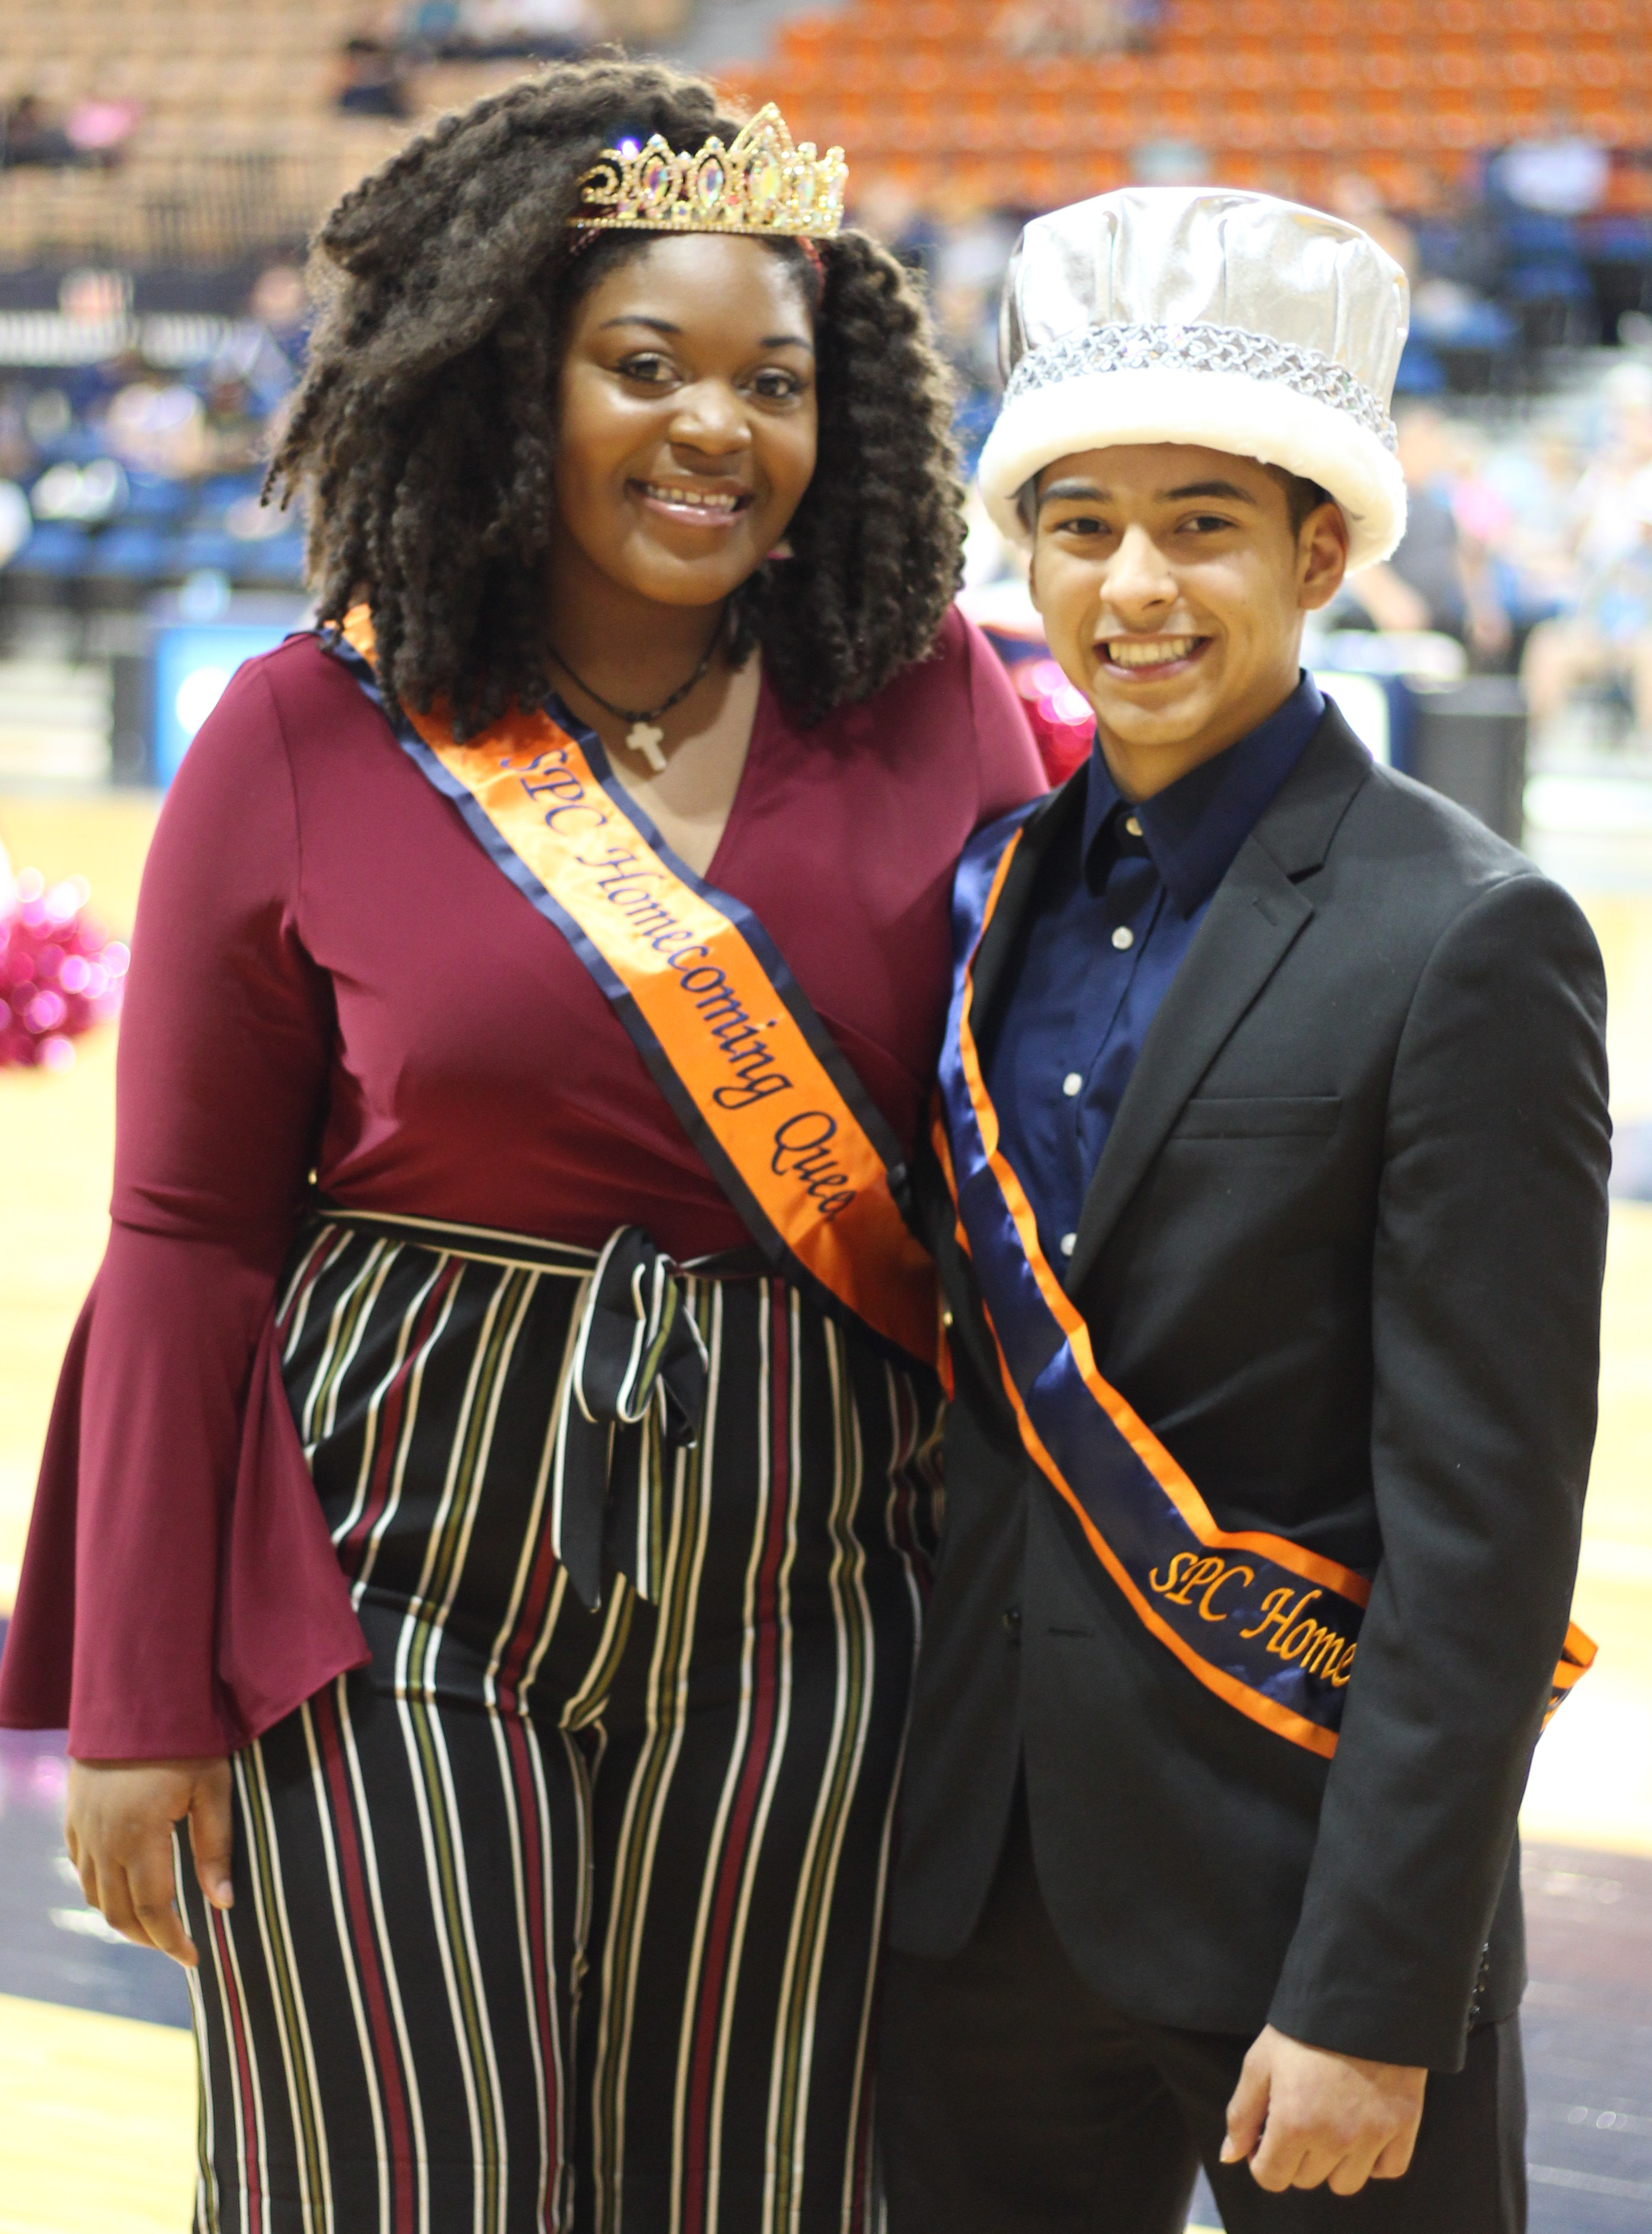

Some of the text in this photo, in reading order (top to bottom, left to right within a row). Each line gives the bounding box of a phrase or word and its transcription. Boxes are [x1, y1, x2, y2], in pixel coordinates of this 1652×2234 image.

[500, 750, 856, 1223] SPC Homecoming Quee
[1149, 1552, 1255, 1621] SPC
